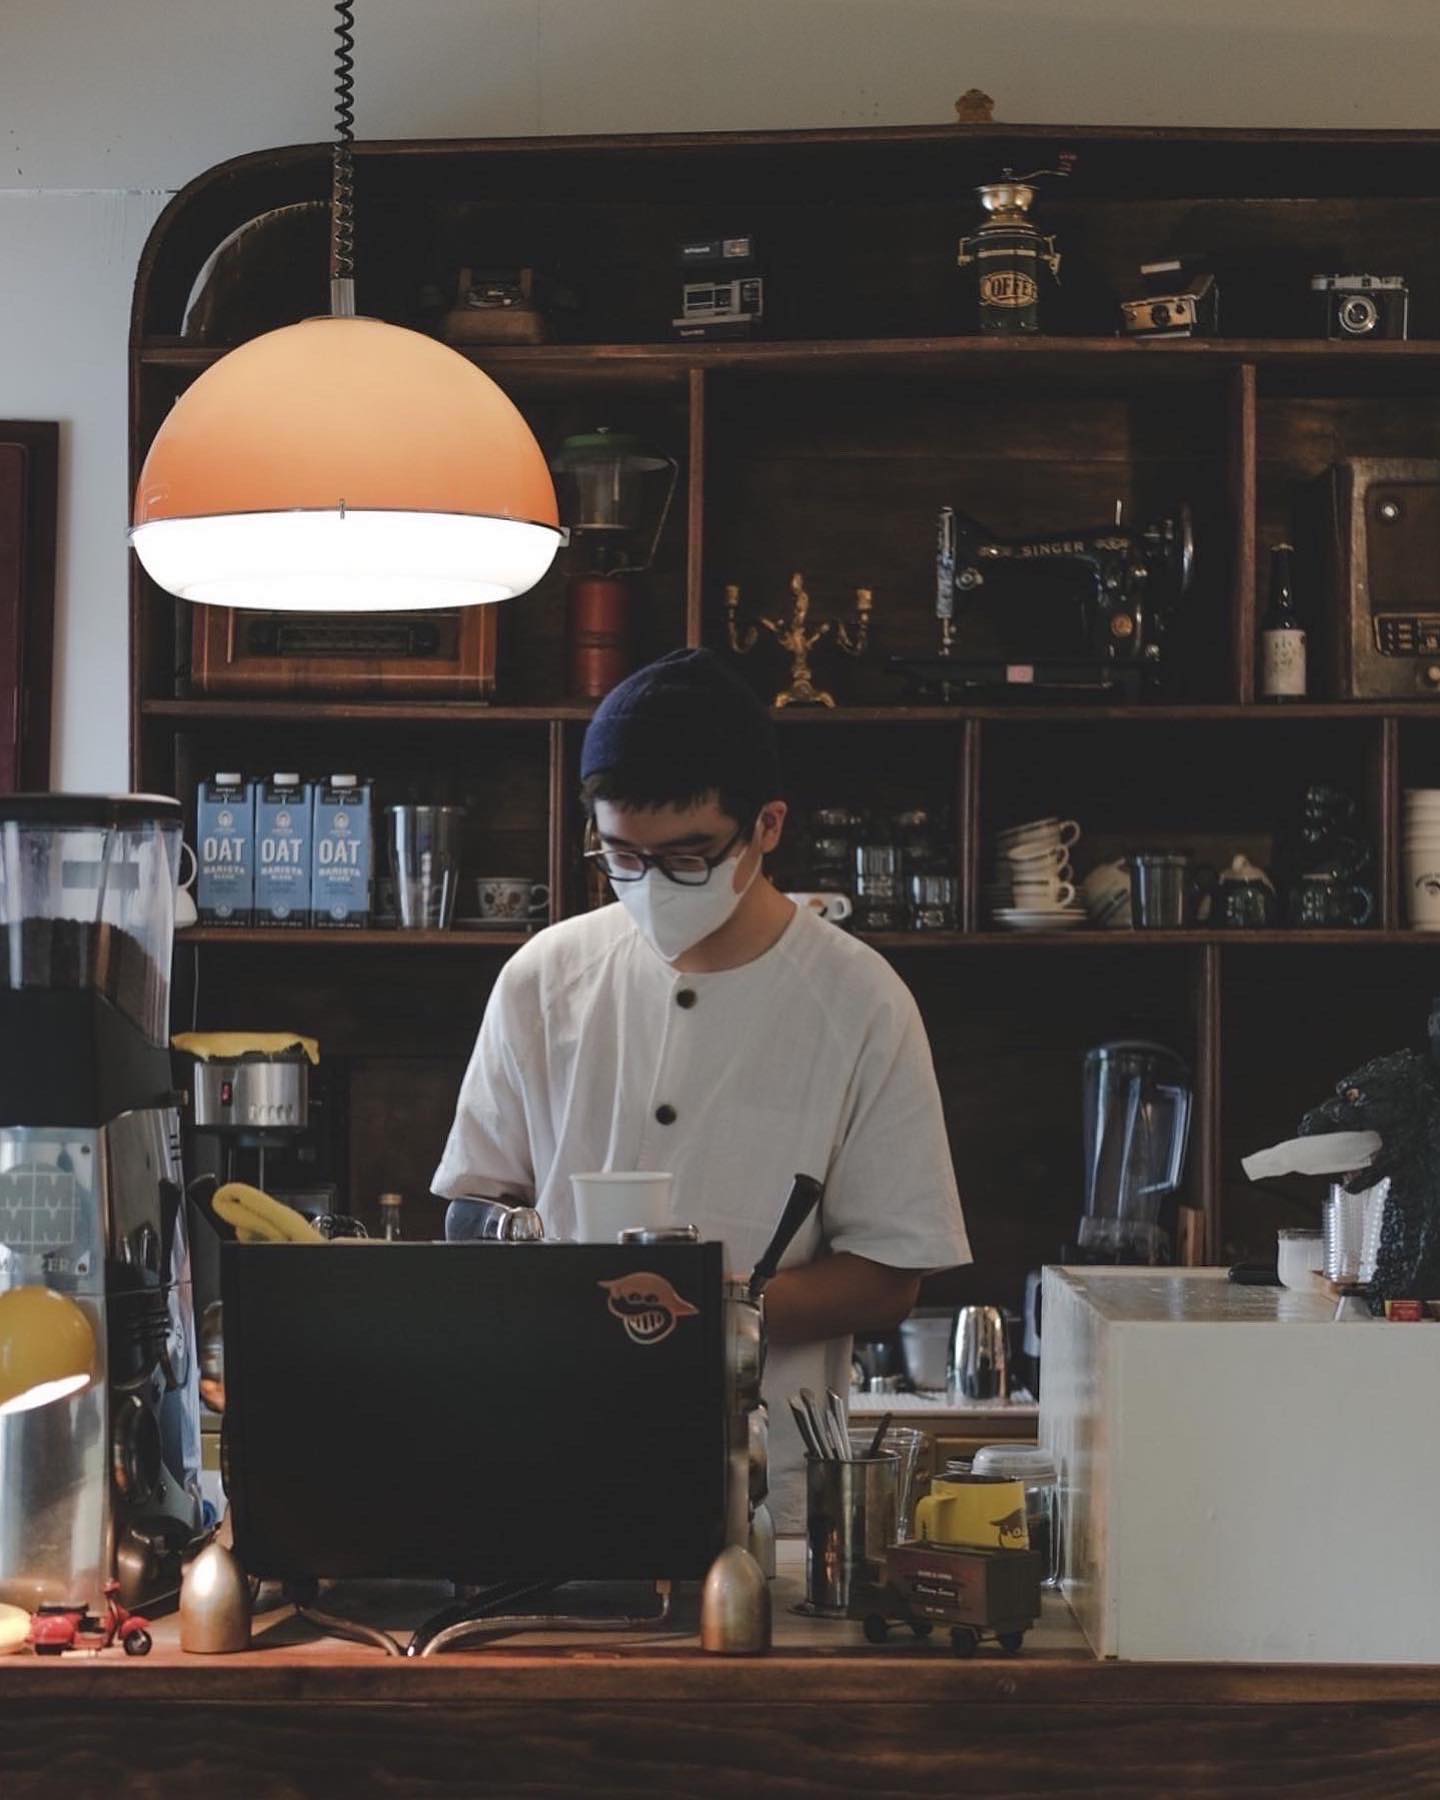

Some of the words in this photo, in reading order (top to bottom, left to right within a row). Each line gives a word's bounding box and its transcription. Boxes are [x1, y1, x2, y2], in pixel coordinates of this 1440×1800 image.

[1021, 541, 1085, 558] SINGER
[203, 837, 246, 862] OAT
[260, 838, 303, 864] OAT
[318, 839, 361, 865] OAT
